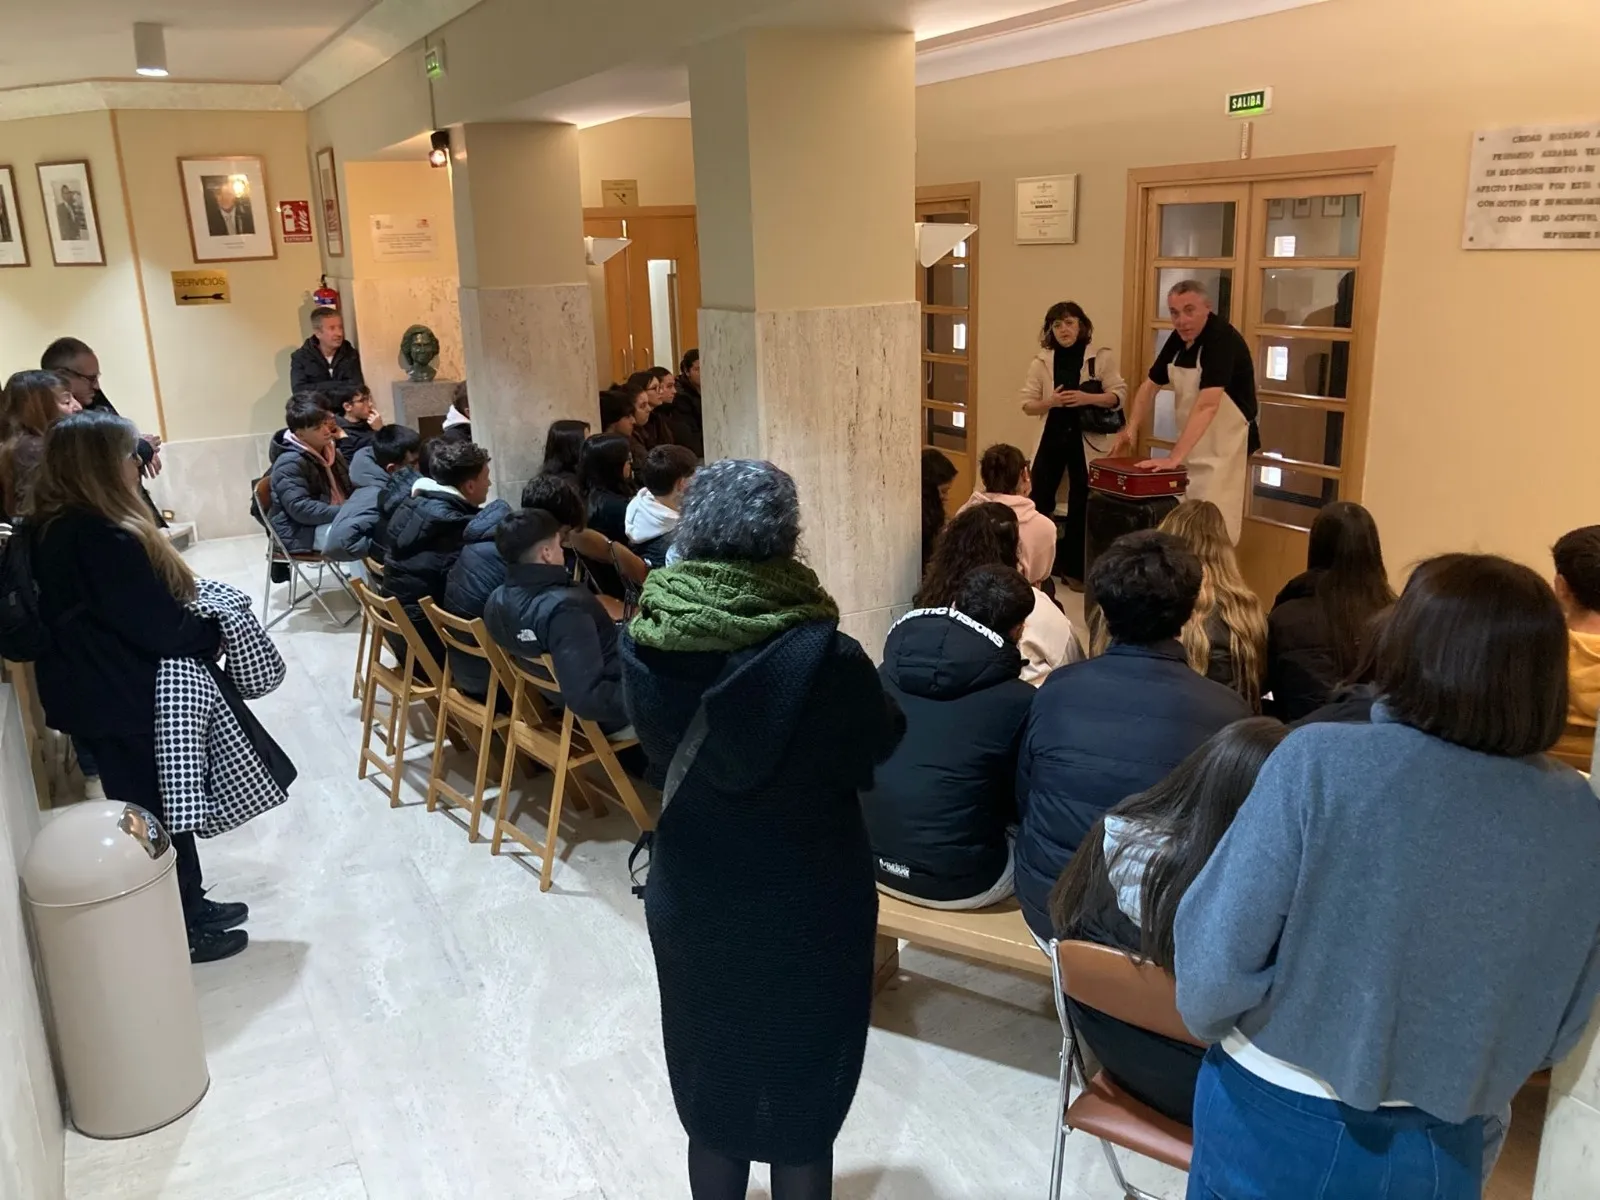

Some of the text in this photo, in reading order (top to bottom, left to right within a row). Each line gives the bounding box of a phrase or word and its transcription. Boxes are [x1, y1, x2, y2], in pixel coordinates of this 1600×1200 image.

[1231, 94, 1261, 109] SALIDA
[175, 276, 226, 287] SERVICIOS
[949, 607, 1004, 648] VISIONS
